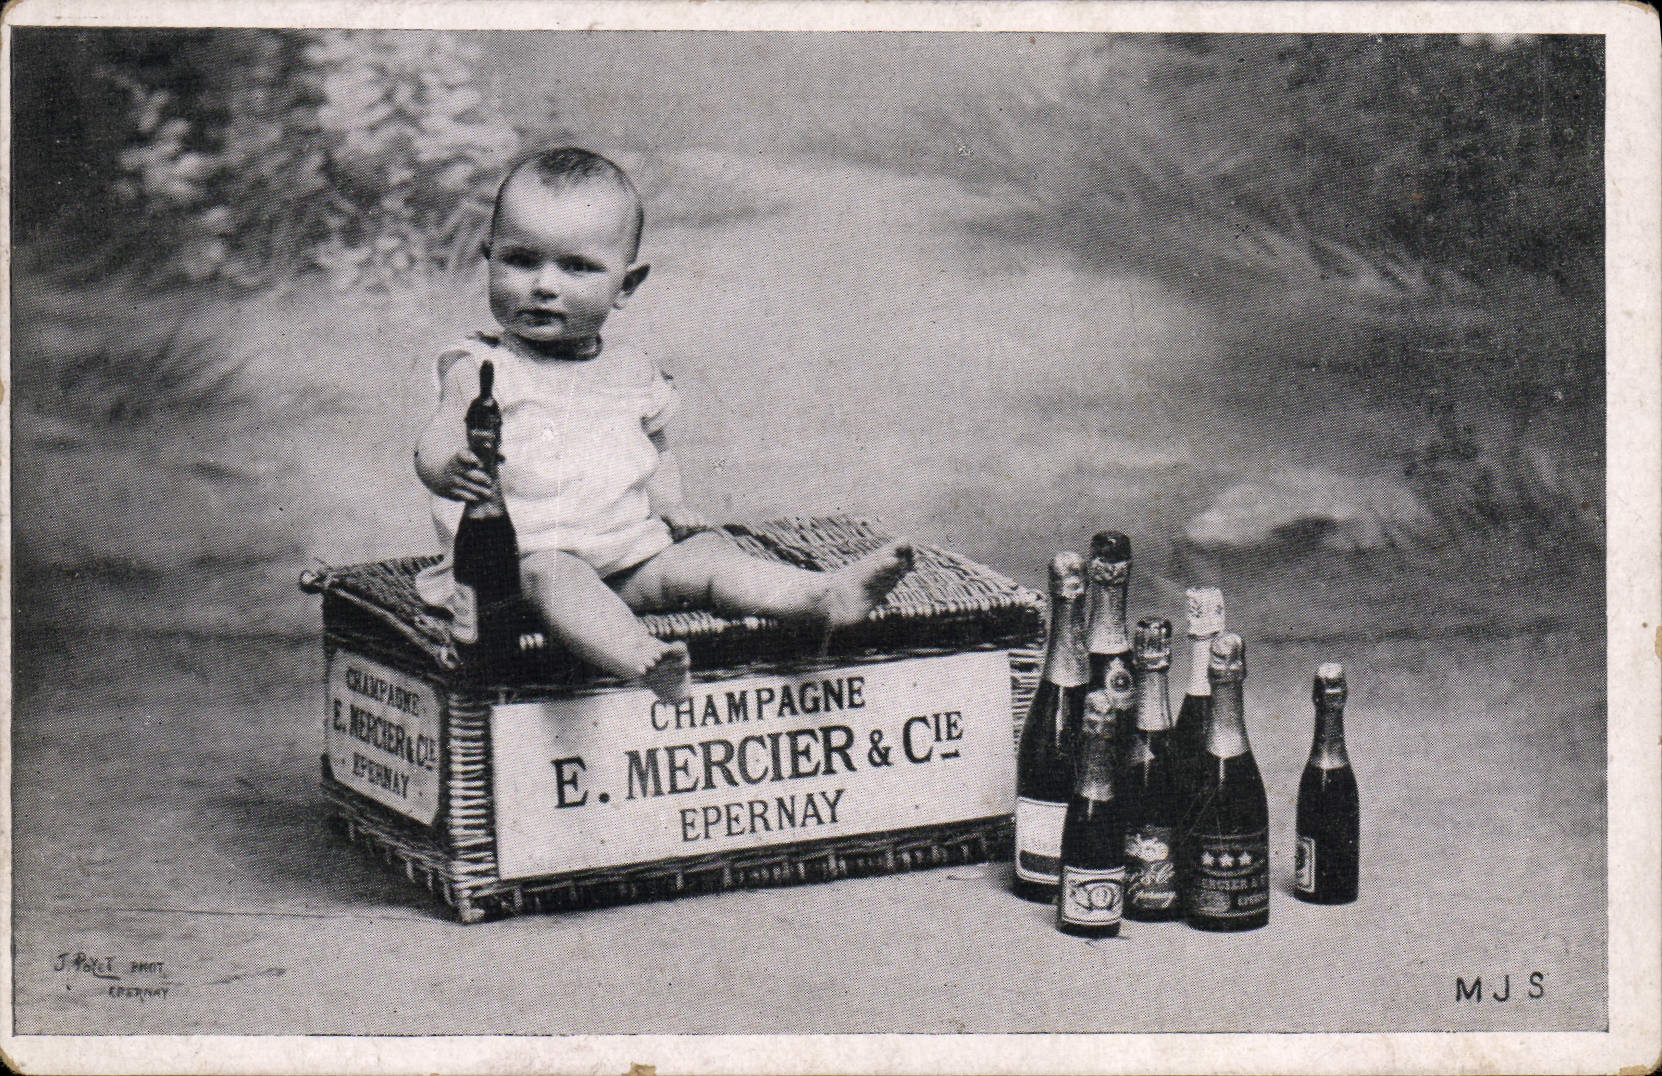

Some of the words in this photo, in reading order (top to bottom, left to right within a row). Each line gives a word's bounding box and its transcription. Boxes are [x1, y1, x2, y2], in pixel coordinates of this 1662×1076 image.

[346, 667, 421, 717] CHAMPAGNE
[650, 677, 866, 732] CHAMPAGNE
[350, 704, 405, 761] MERCIER
[353, 752, 408, 799] EPERNAY
[554, 756, 610, 809] E.
[625, 726, 857, 800] MERCIER
[868, 730, 893, 769] &
[680, 789, 846, 843] EPERNAY
